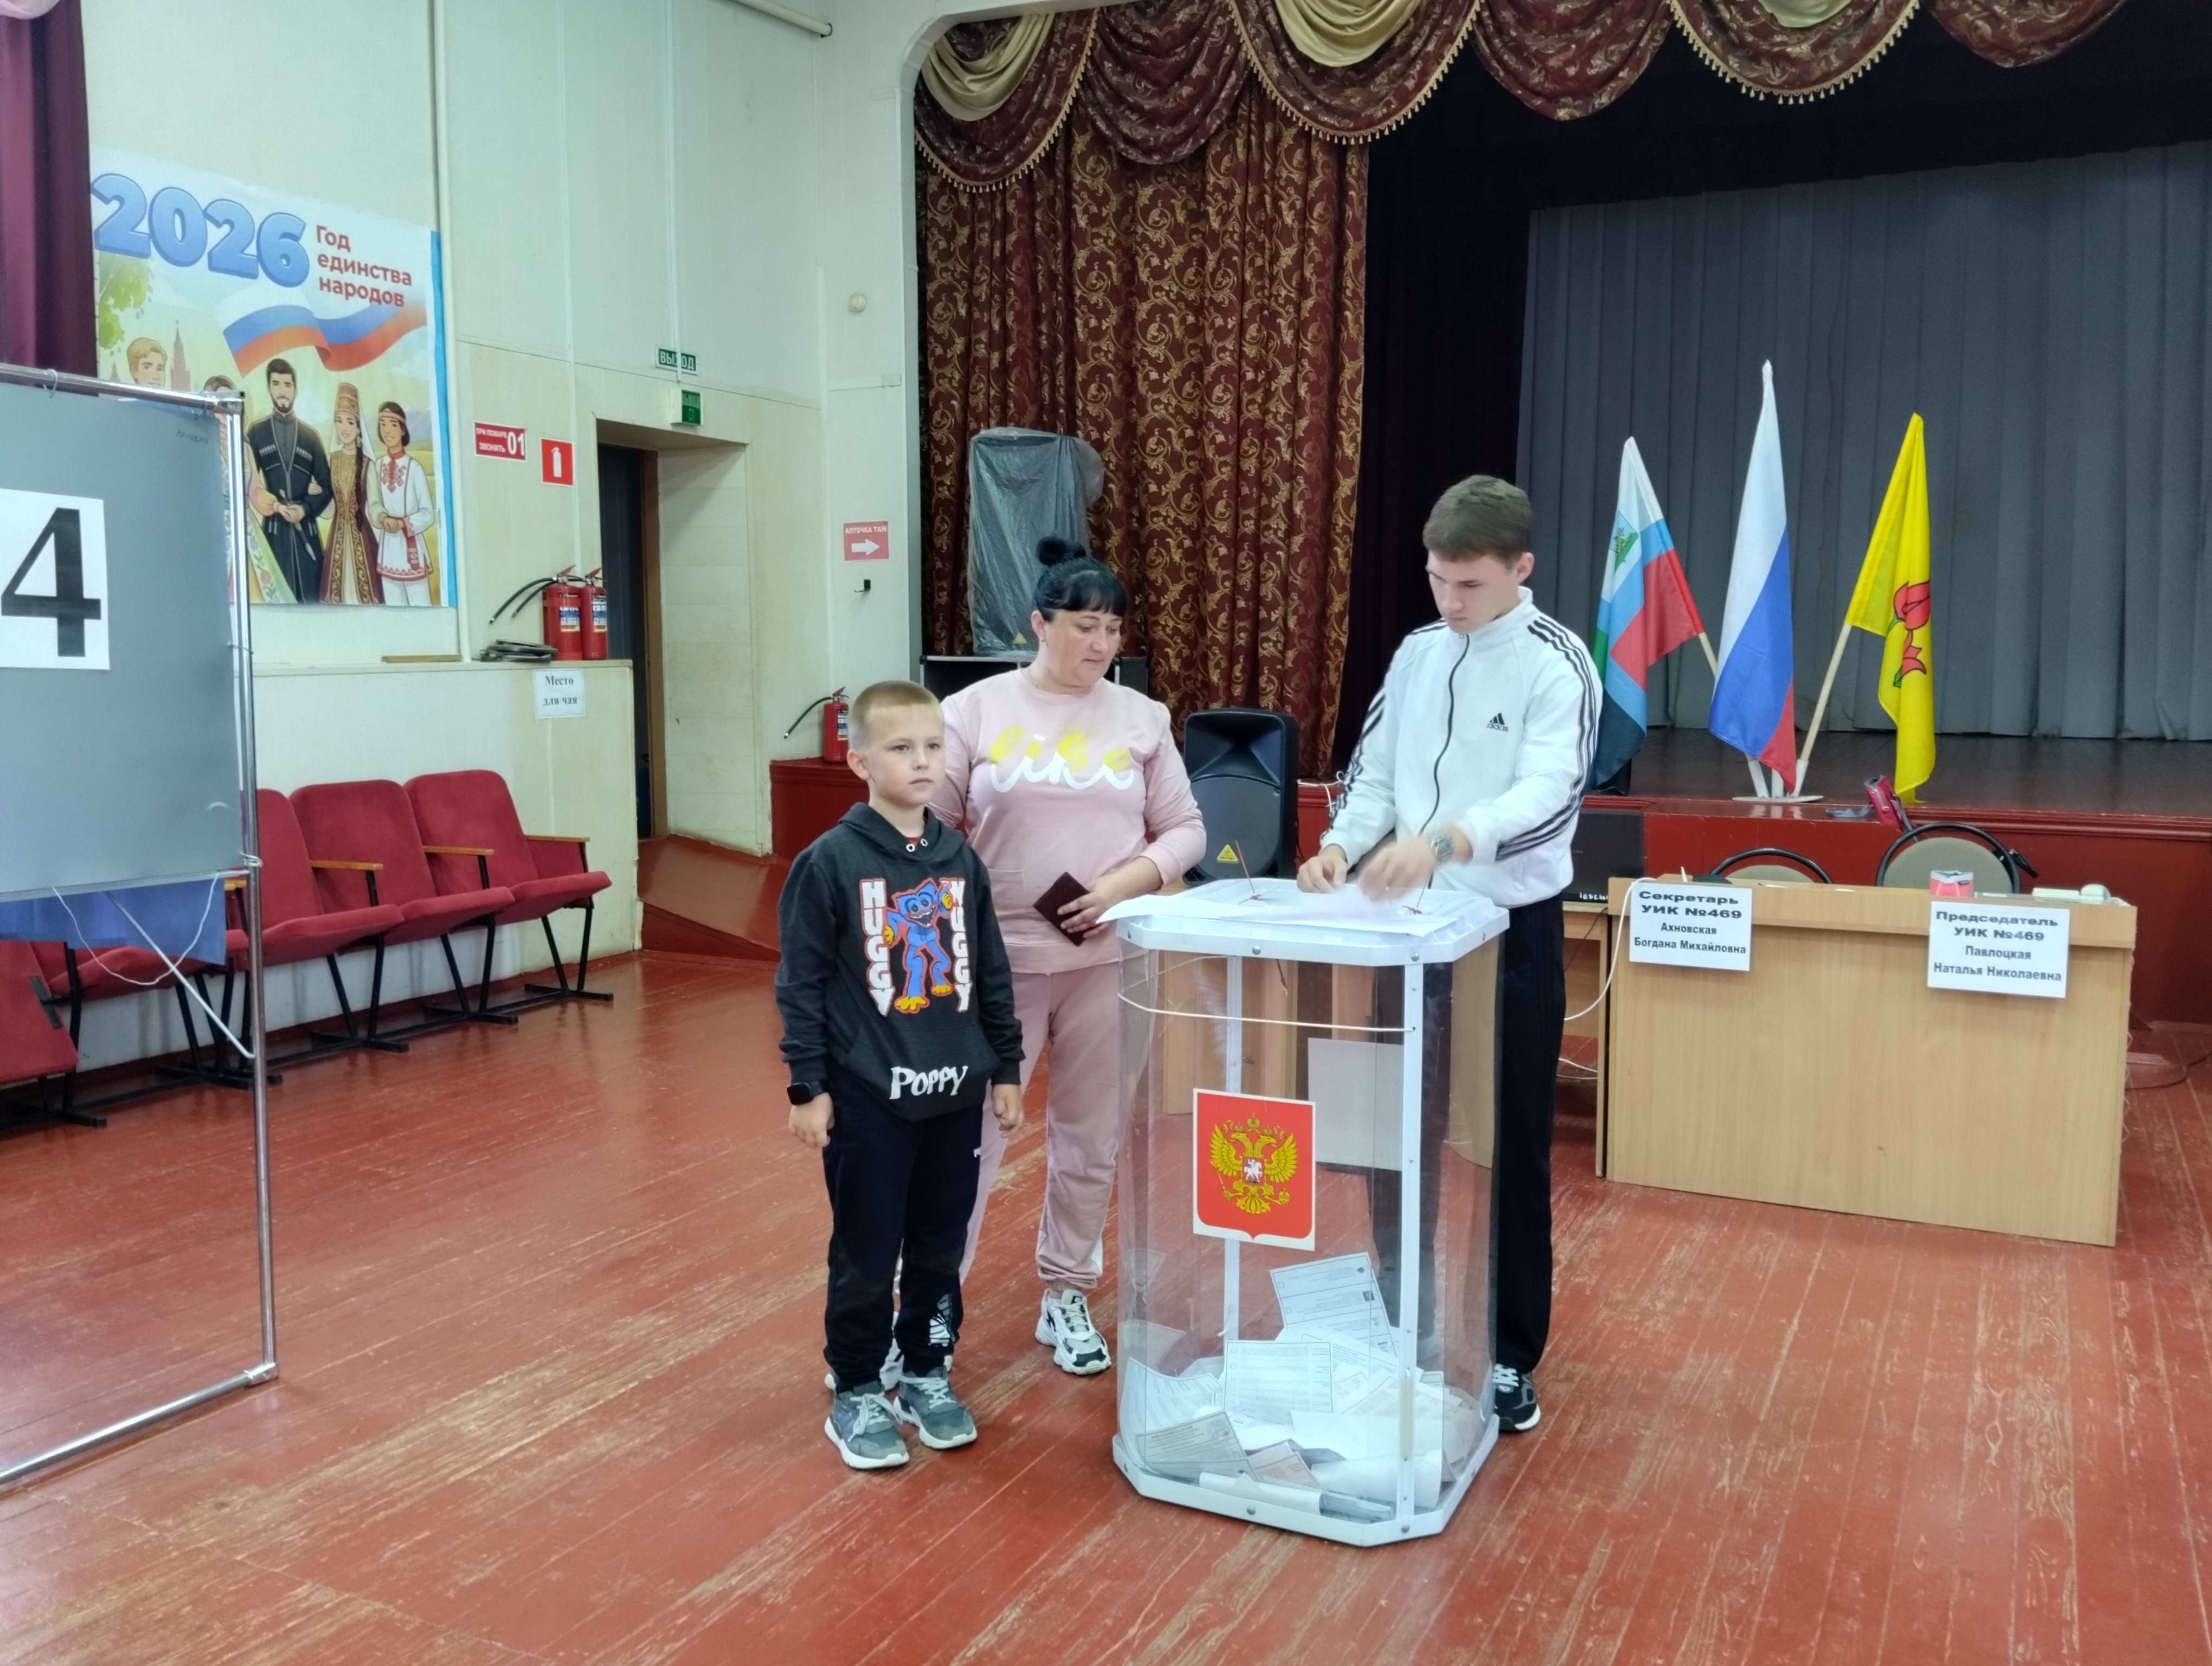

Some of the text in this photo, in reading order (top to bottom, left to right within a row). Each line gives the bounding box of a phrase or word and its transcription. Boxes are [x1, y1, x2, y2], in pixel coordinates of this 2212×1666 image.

[91, 172, 310, 288] 2026
[316, 225, 351, 251] Год
[317, 252, 412, 287] единства
[318, 277, 404, 307] народов
[660, 351, 695, 370] ВЫОД
[479, 442, 506, 453] ЗВОНИТЬ
[507, 431, 525, 456] 01
[1, 507, 102, 657] 4
[545, 676, 574, 685] Место
[543, 697, 559, 706] для
[1639, 891, 1739, 905] Секретарь
[1642, 905, 1742, 919] УИК №469
[1936, 911, 2058, 926] Председатель
[1661, 922, 1717, 934] Ахновская
[1954, 927, 2044, 941] УИК №469
[861, 880, 893, 1016] HUGGY
[1635, 937, 1746, 954] Богдана Михайловна
[1965, 946, 2031, 959] Павлоцкая
[1933, 963, 2062, 981] Наталья Николаевна
